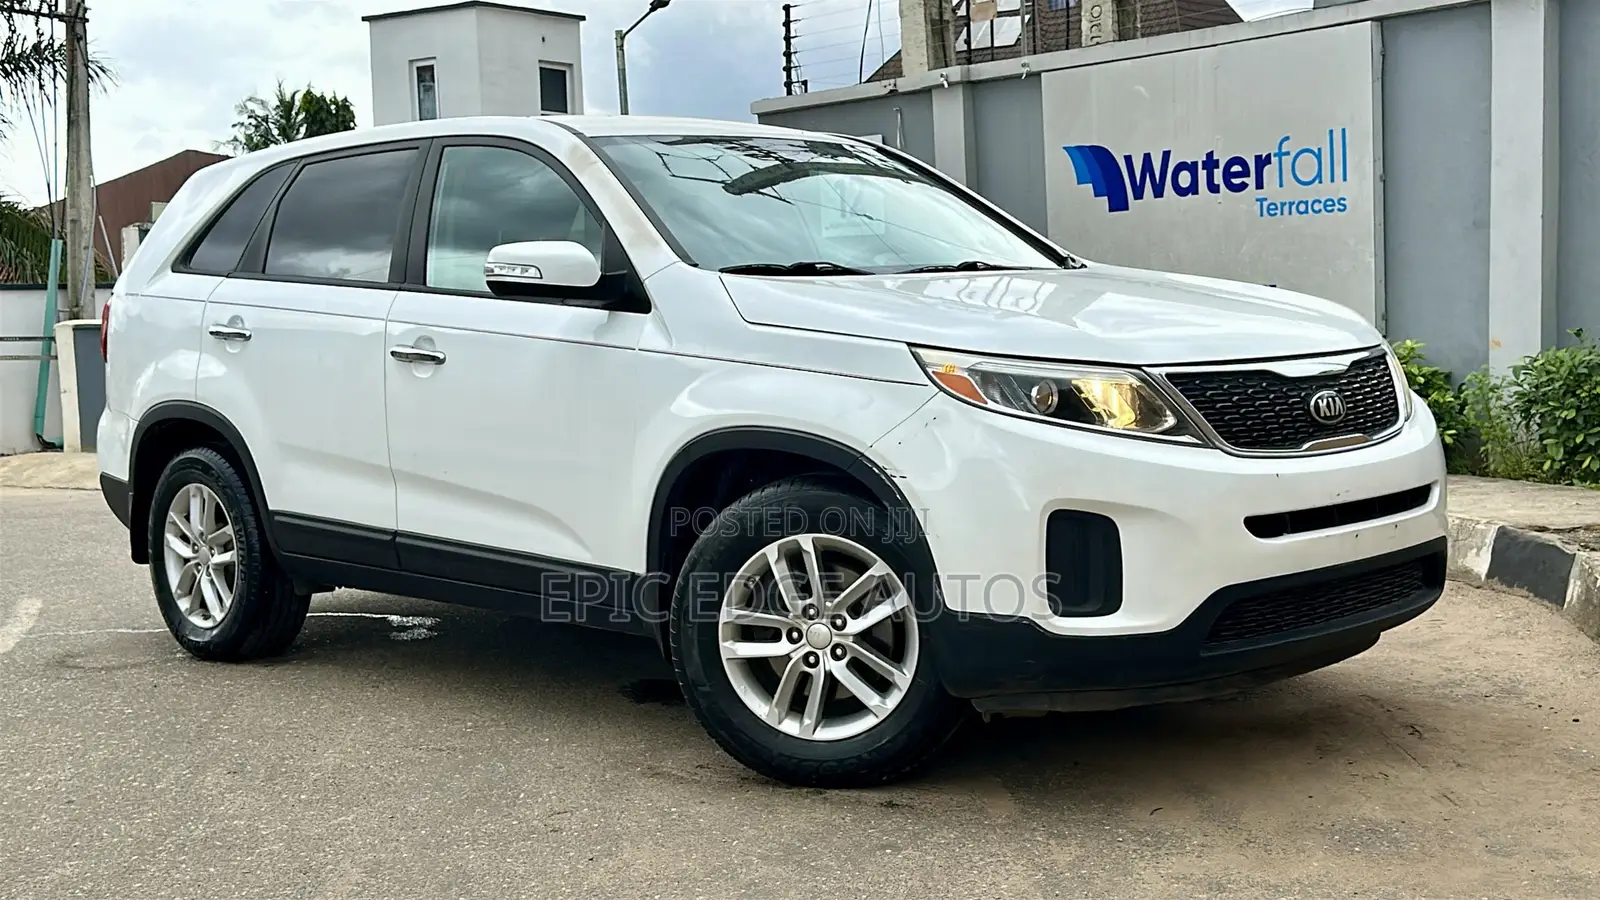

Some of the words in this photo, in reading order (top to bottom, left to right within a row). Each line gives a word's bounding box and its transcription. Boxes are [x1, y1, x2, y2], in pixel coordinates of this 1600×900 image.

[1123, 127, 1348, 201] Waterfall
[1255, 196, 1348, 217] Terraces
[1317, 396, 1344, 417] KIA
